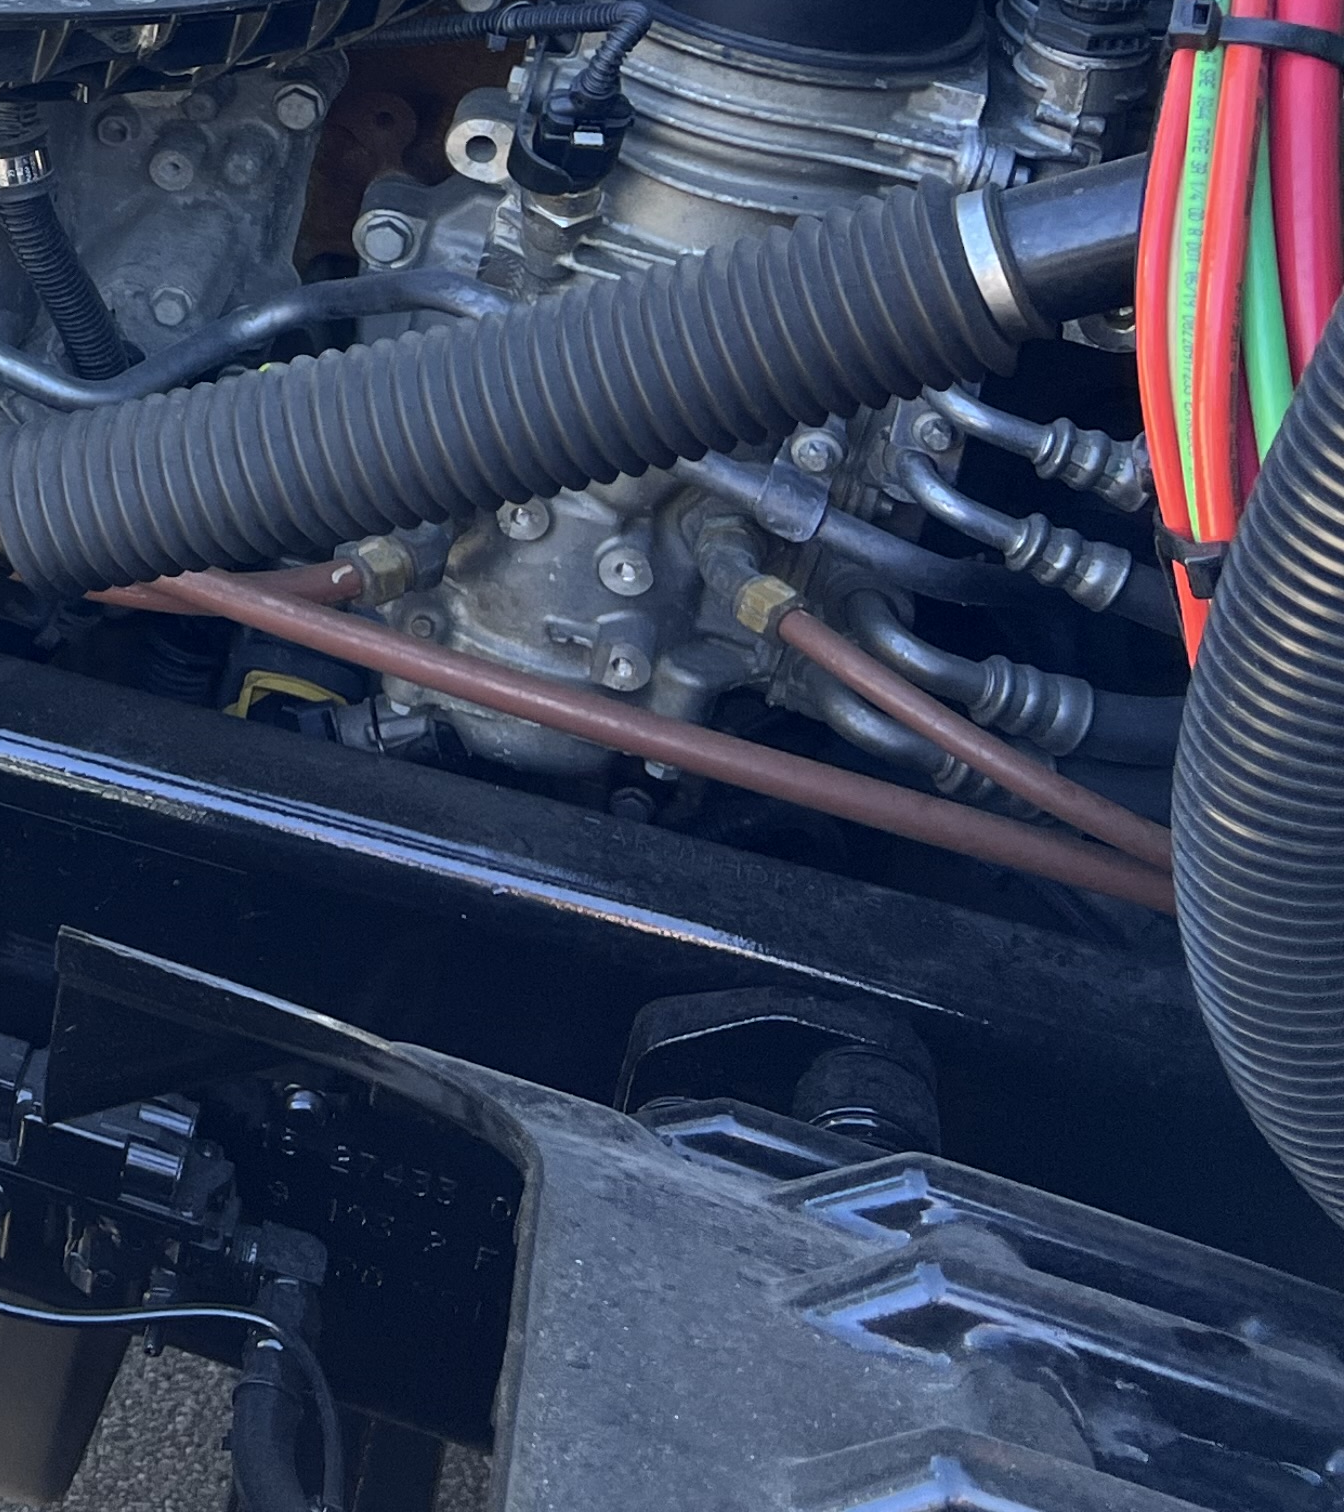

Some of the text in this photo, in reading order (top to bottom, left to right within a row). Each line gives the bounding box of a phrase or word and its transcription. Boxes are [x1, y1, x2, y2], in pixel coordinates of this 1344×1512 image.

[1199, 68, 1216, 89] SAE
[1192, 127, 1211, 155] TYPE
[1191, 160, 1208, 175] 3A
[1188, 181, 1206, 201] 1/4
[1184, 240, 1200, 262] DOT
